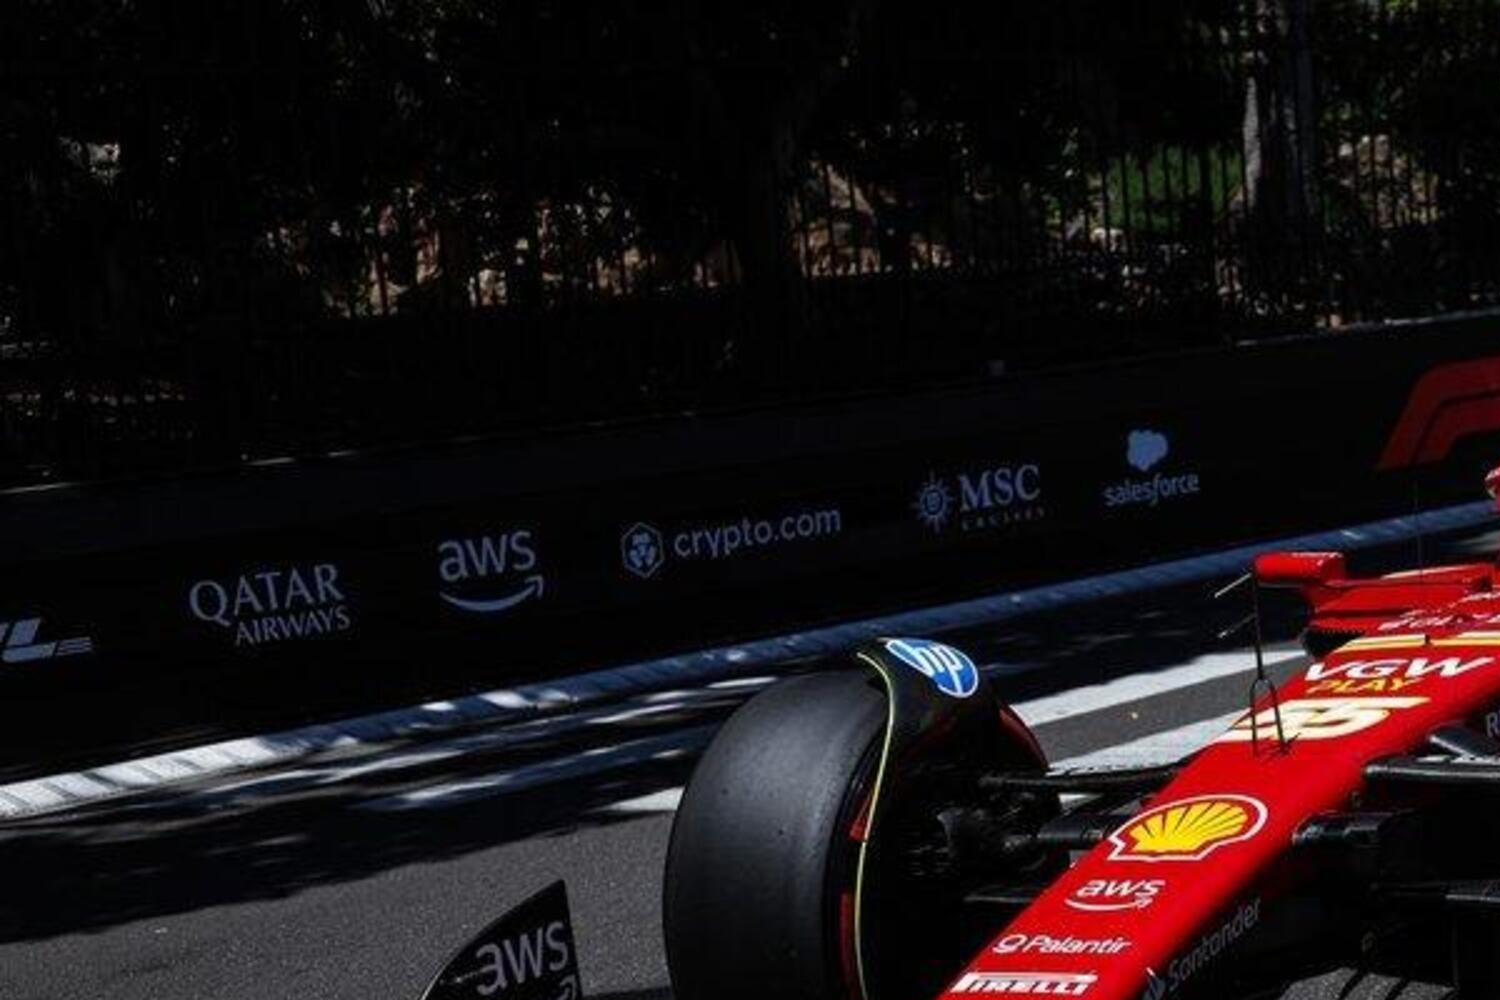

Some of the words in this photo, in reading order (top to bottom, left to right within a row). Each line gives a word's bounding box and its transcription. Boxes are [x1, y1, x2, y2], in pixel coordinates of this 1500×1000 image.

[957, 463, 1042, 514] MSC
[1102, 471, 1201, 508] salesforce
[437, 529, 537, 582] aws
[673, 508, 842, 559] crypto.com
[188, 563, 347, 628] QATAR
[232, 603, 352, 648] AIRWAYS
[889, 639, 968, 696] hp
[1304, 656, 1496, 682] VGW
[1304, 677, 1425, 695] PLAY
[1076, 879, 1167, 898] aws
[474, 920, 570, 996] aws
[1022, 934, 1132, 954] Palantir
[1166, 896, 1262, 994] Santander
[950, 971, 1099, 997] PIRELLI
